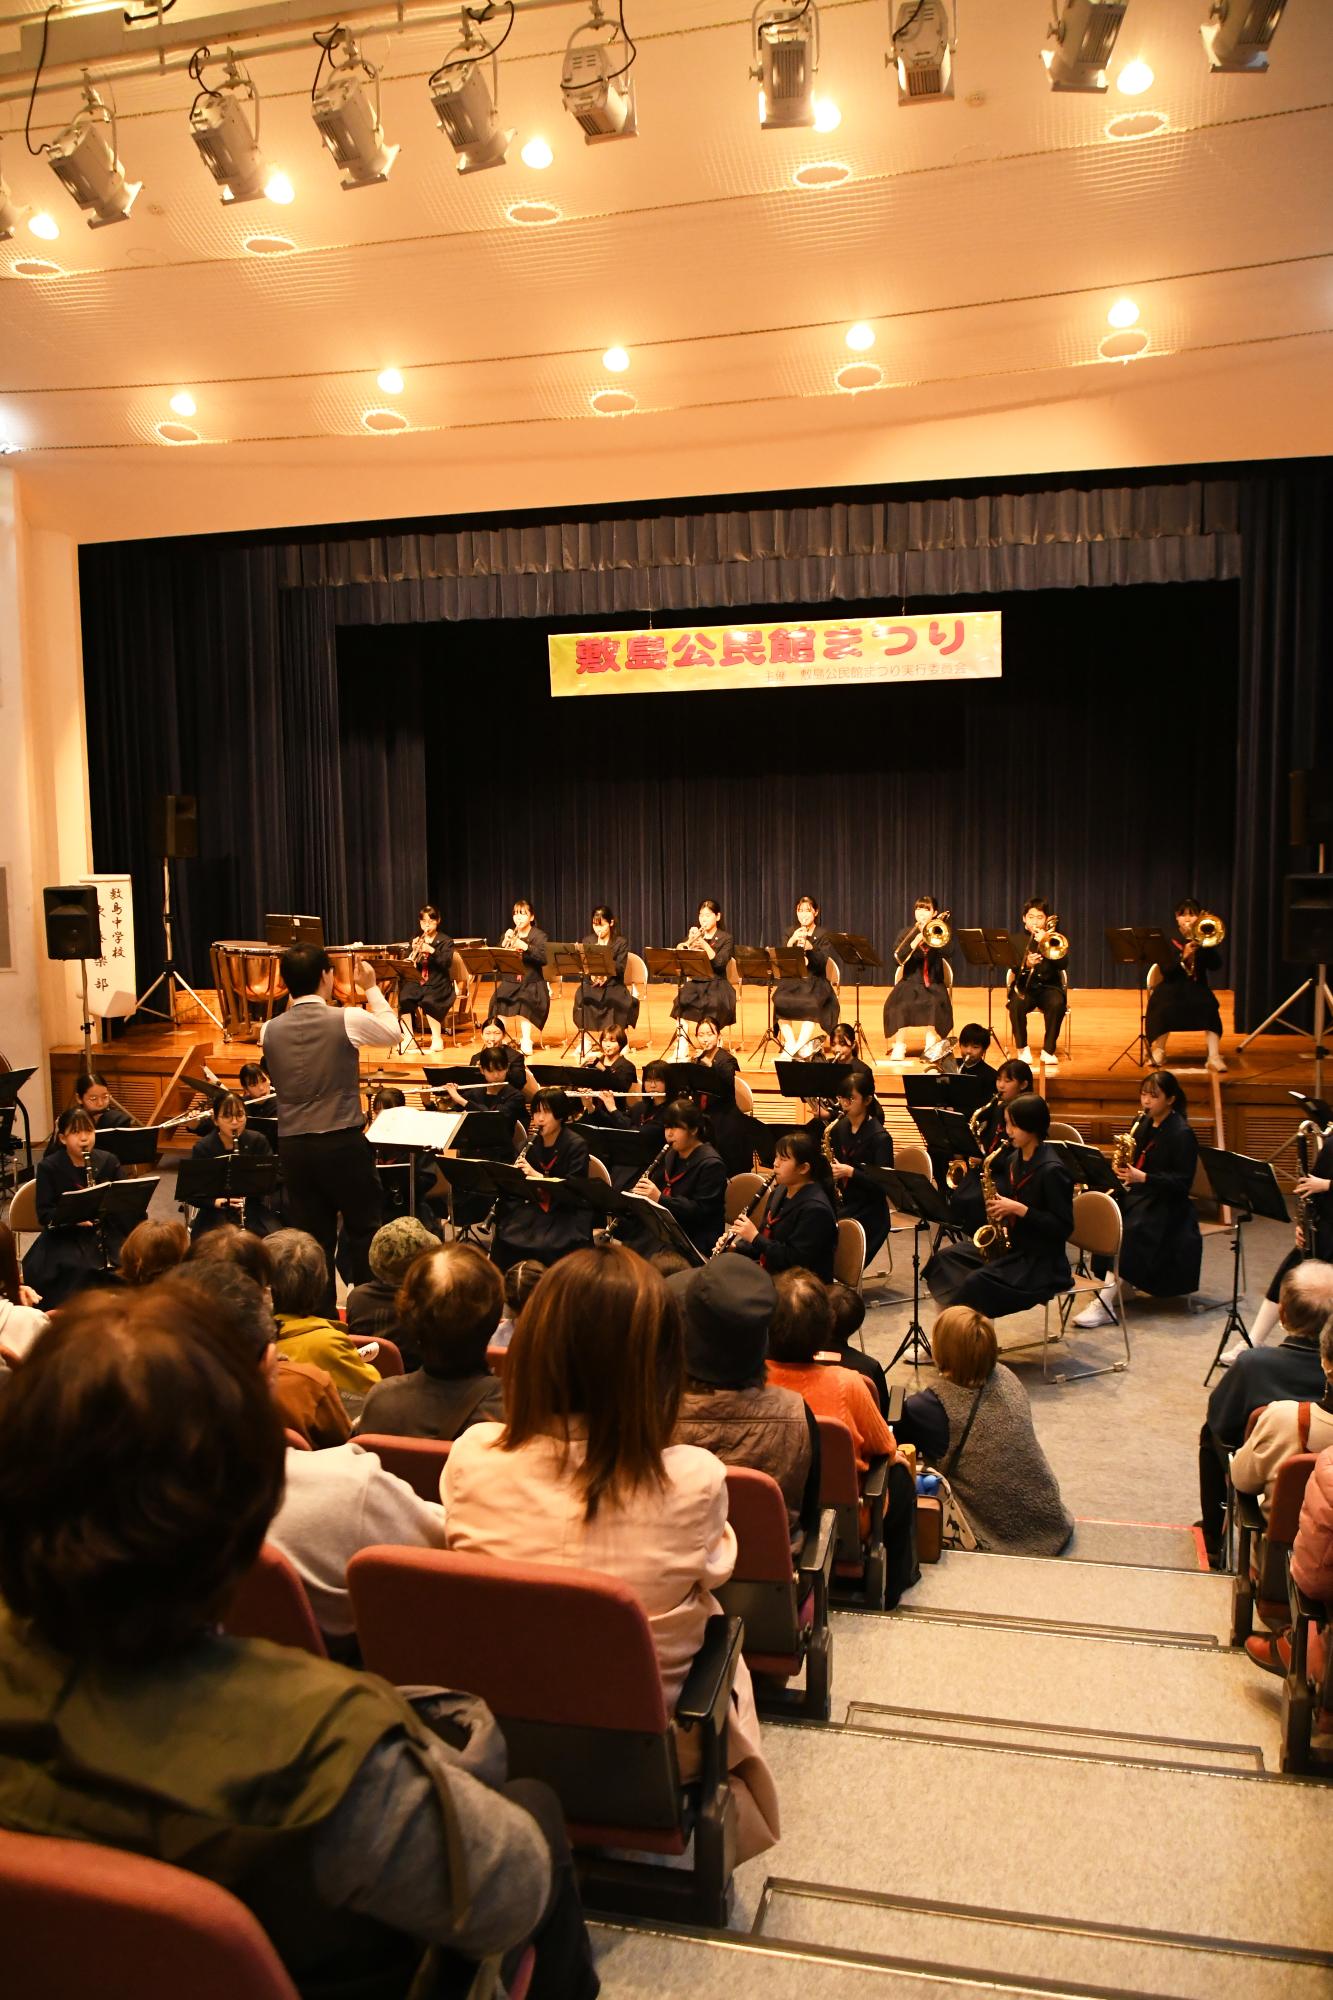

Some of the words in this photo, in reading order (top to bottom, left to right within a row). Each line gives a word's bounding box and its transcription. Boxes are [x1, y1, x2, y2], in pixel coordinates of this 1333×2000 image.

[576, 621, 964, 674] 敷島公民館まつり
